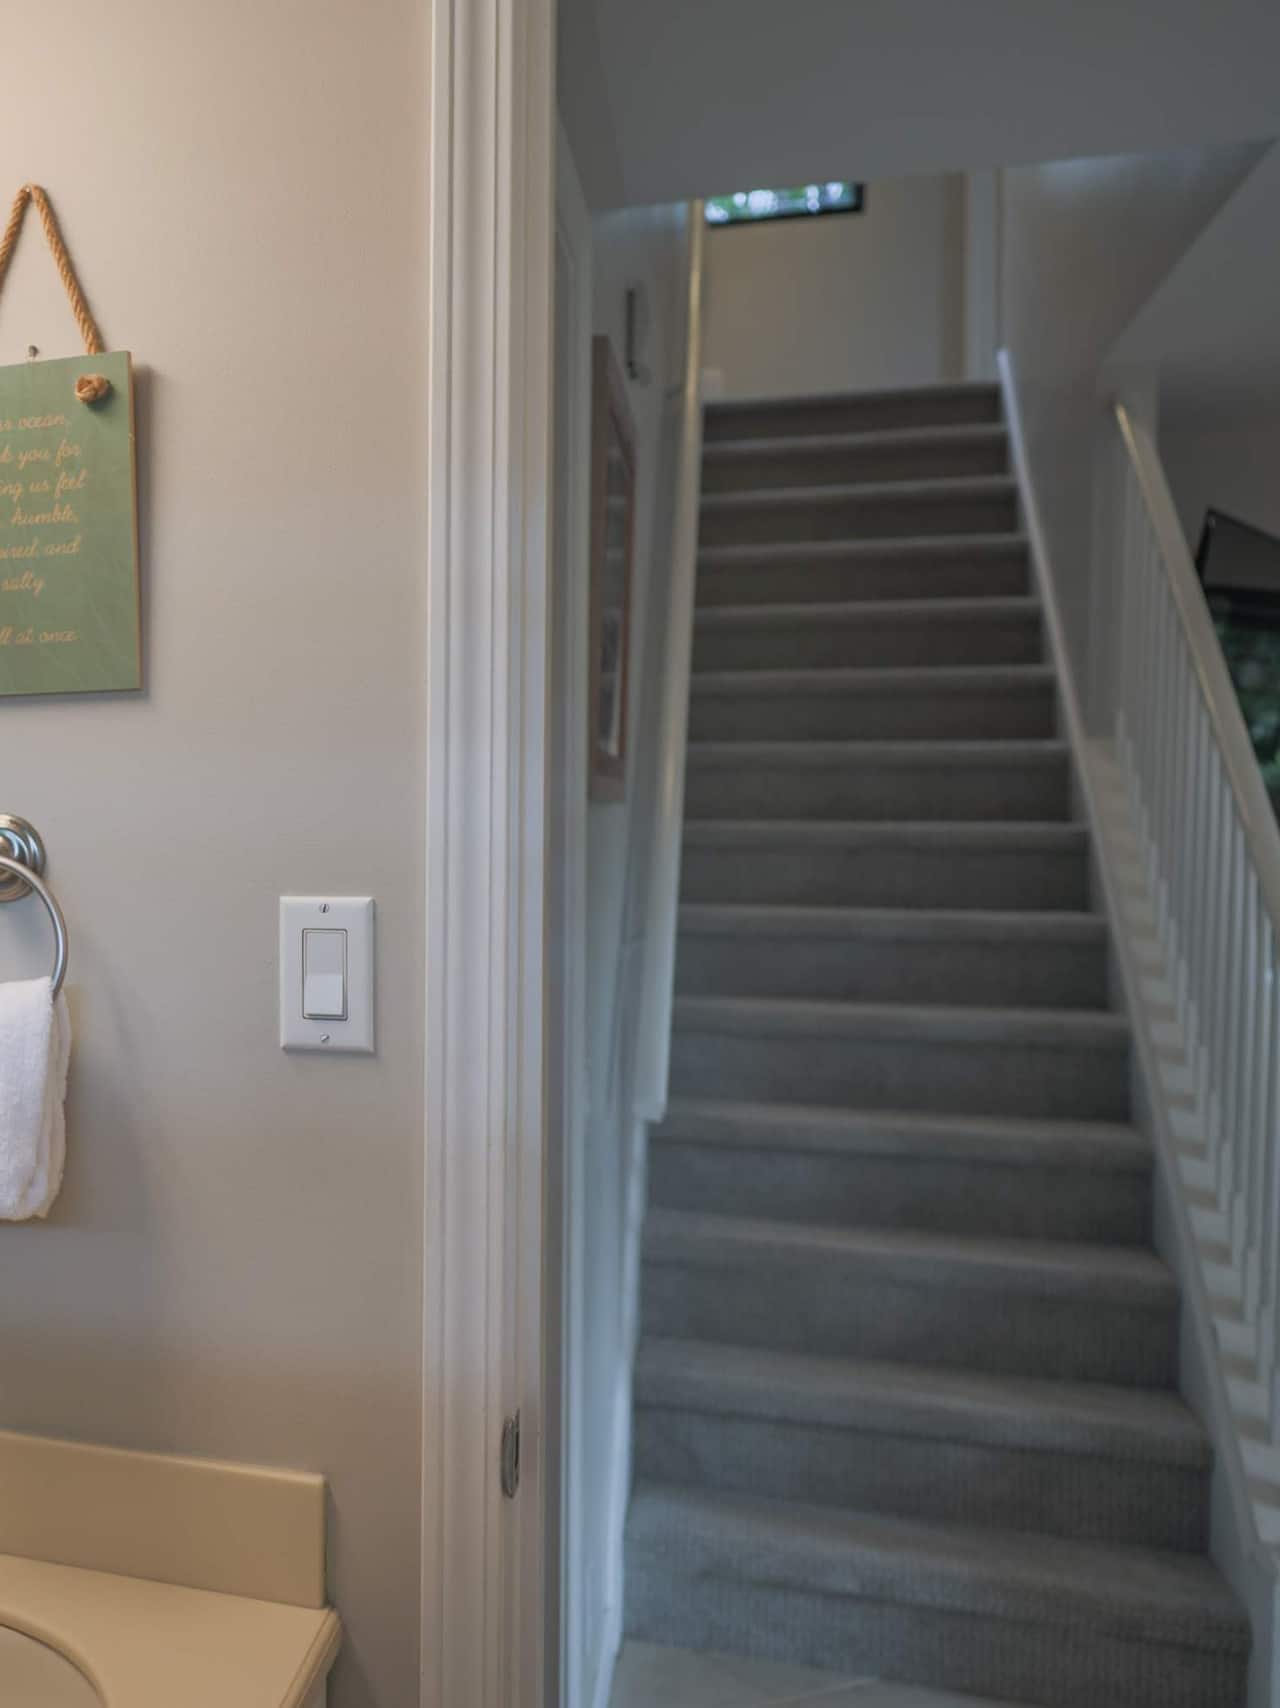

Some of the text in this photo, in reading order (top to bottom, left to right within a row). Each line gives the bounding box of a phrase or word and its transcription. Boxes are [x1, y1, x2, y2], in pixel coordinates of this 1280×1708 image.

[17, 447, 50, 471] you
[55, 439, 81, 468] for
[30, 482, 50, 493] us
[44, 533, 82, 555] and
[1, 569, 46, 599] salty
